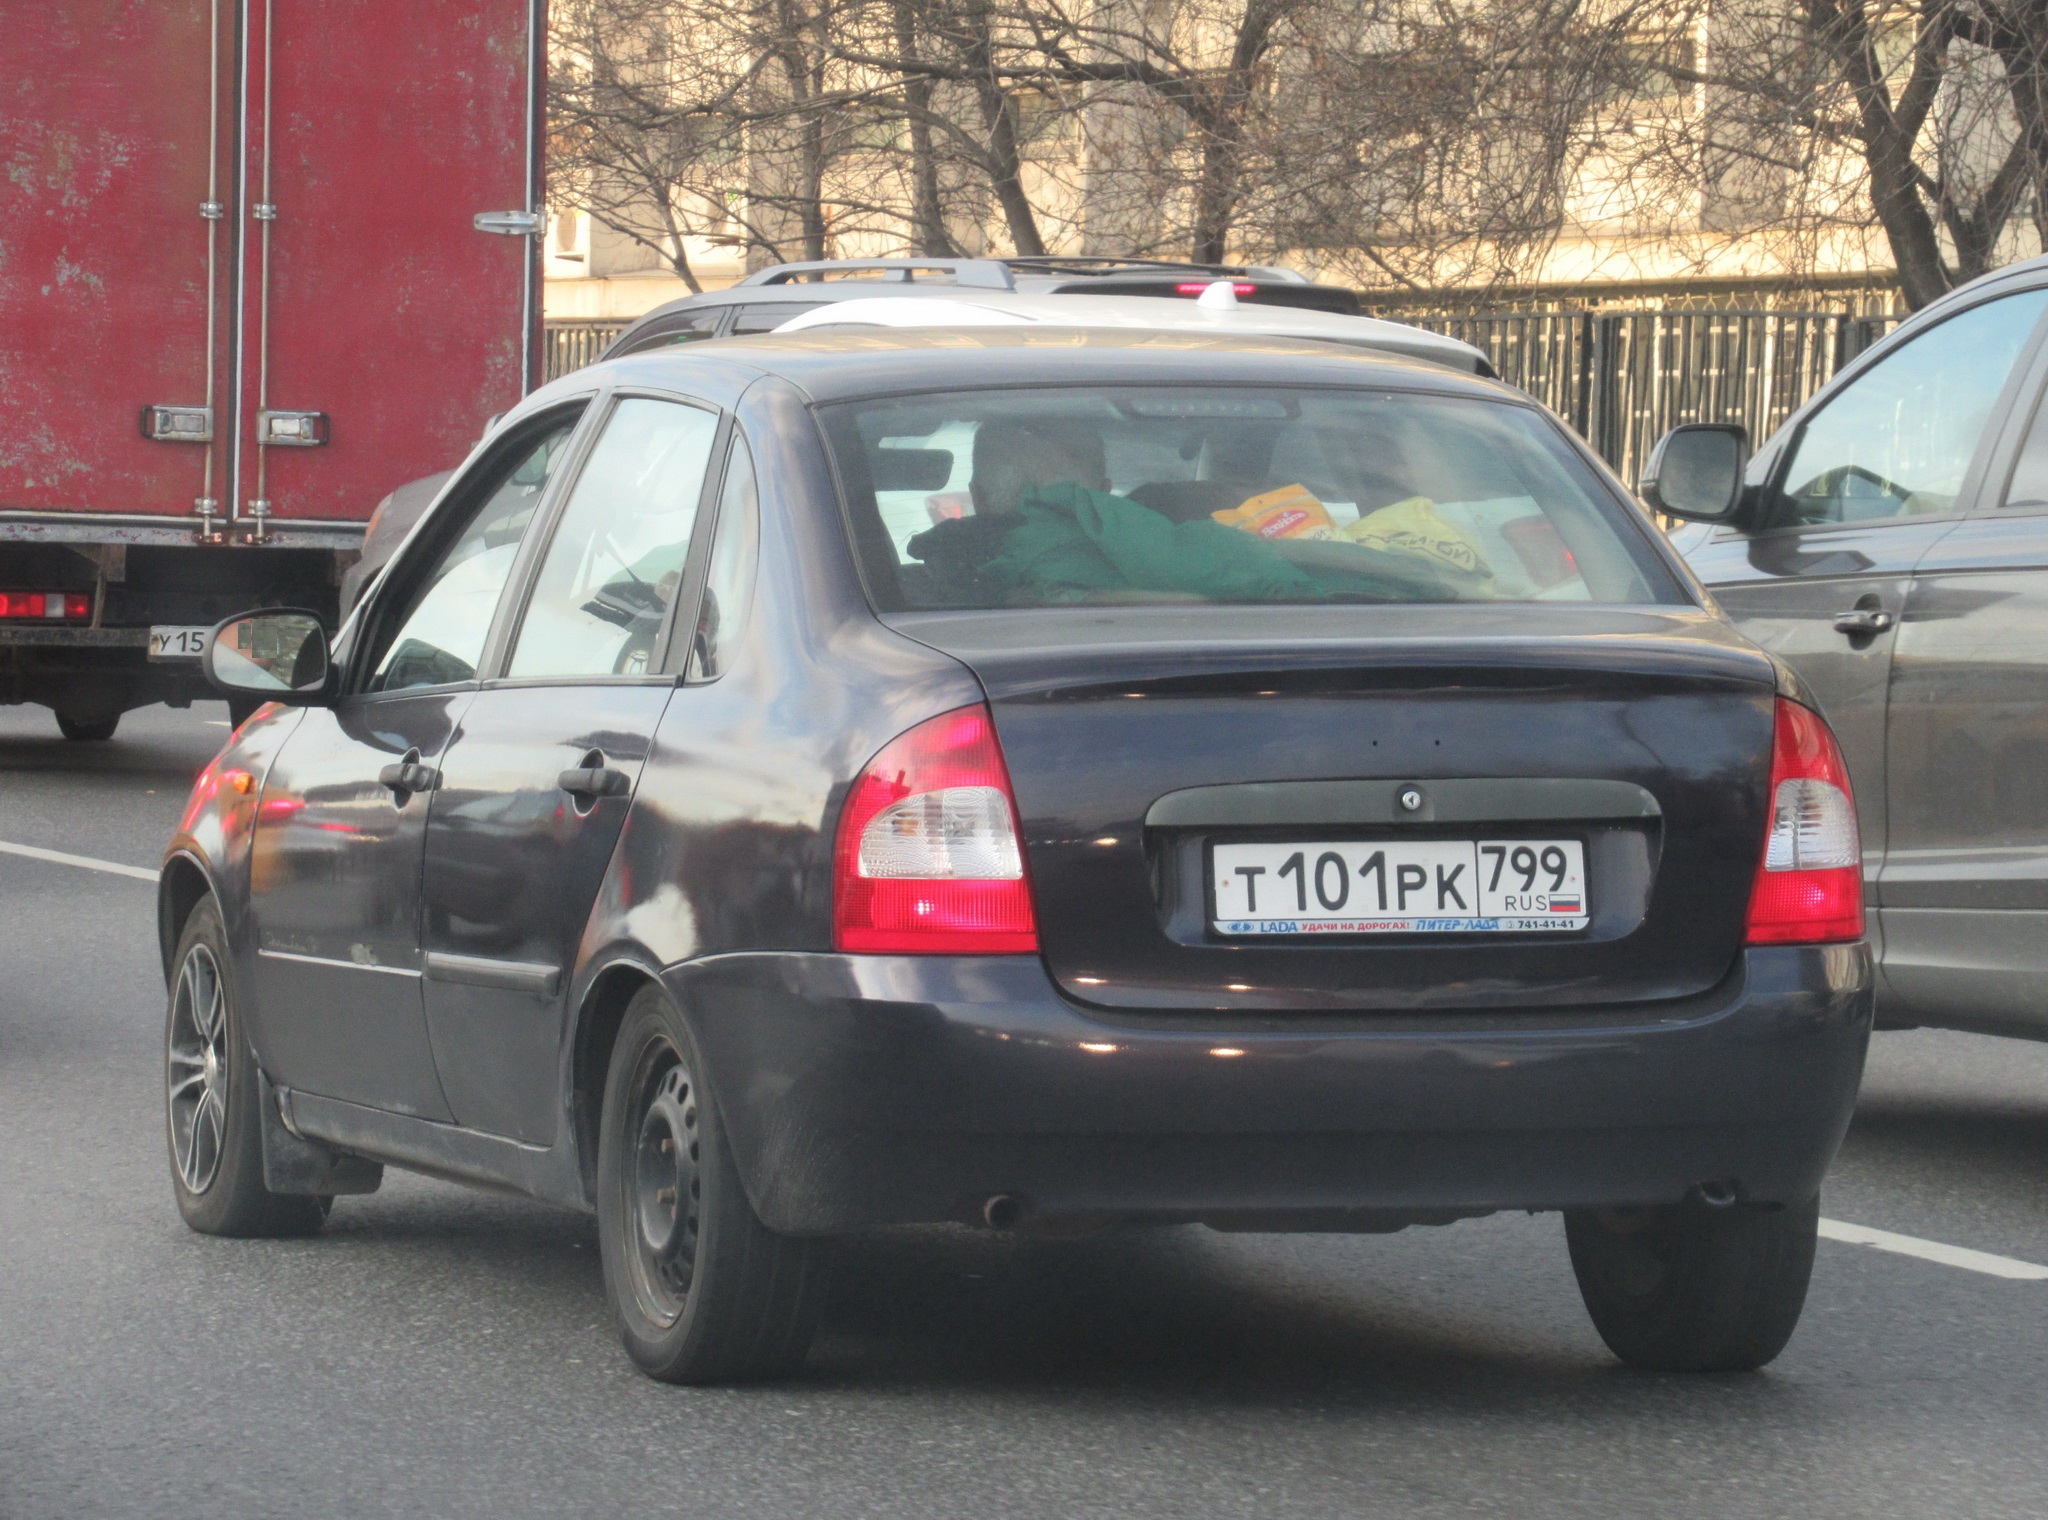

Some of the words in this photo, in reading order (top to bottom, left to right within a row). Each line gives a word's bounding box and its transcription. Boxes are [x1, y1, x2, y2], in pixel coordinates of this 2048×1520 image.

[1481, 845, 1567, 892] 799
[1505, 895, 1547, 912] RUS
[1260, 921, 1298, 933] LADA
[1302, 923, 1338, 931] УДАЧИ
[1341, 923, 1355, 931] НА
[1358, 922, 1410, 931] ДОРОГАХ!
[1518, 920, 1575, 929] 741-41-41
